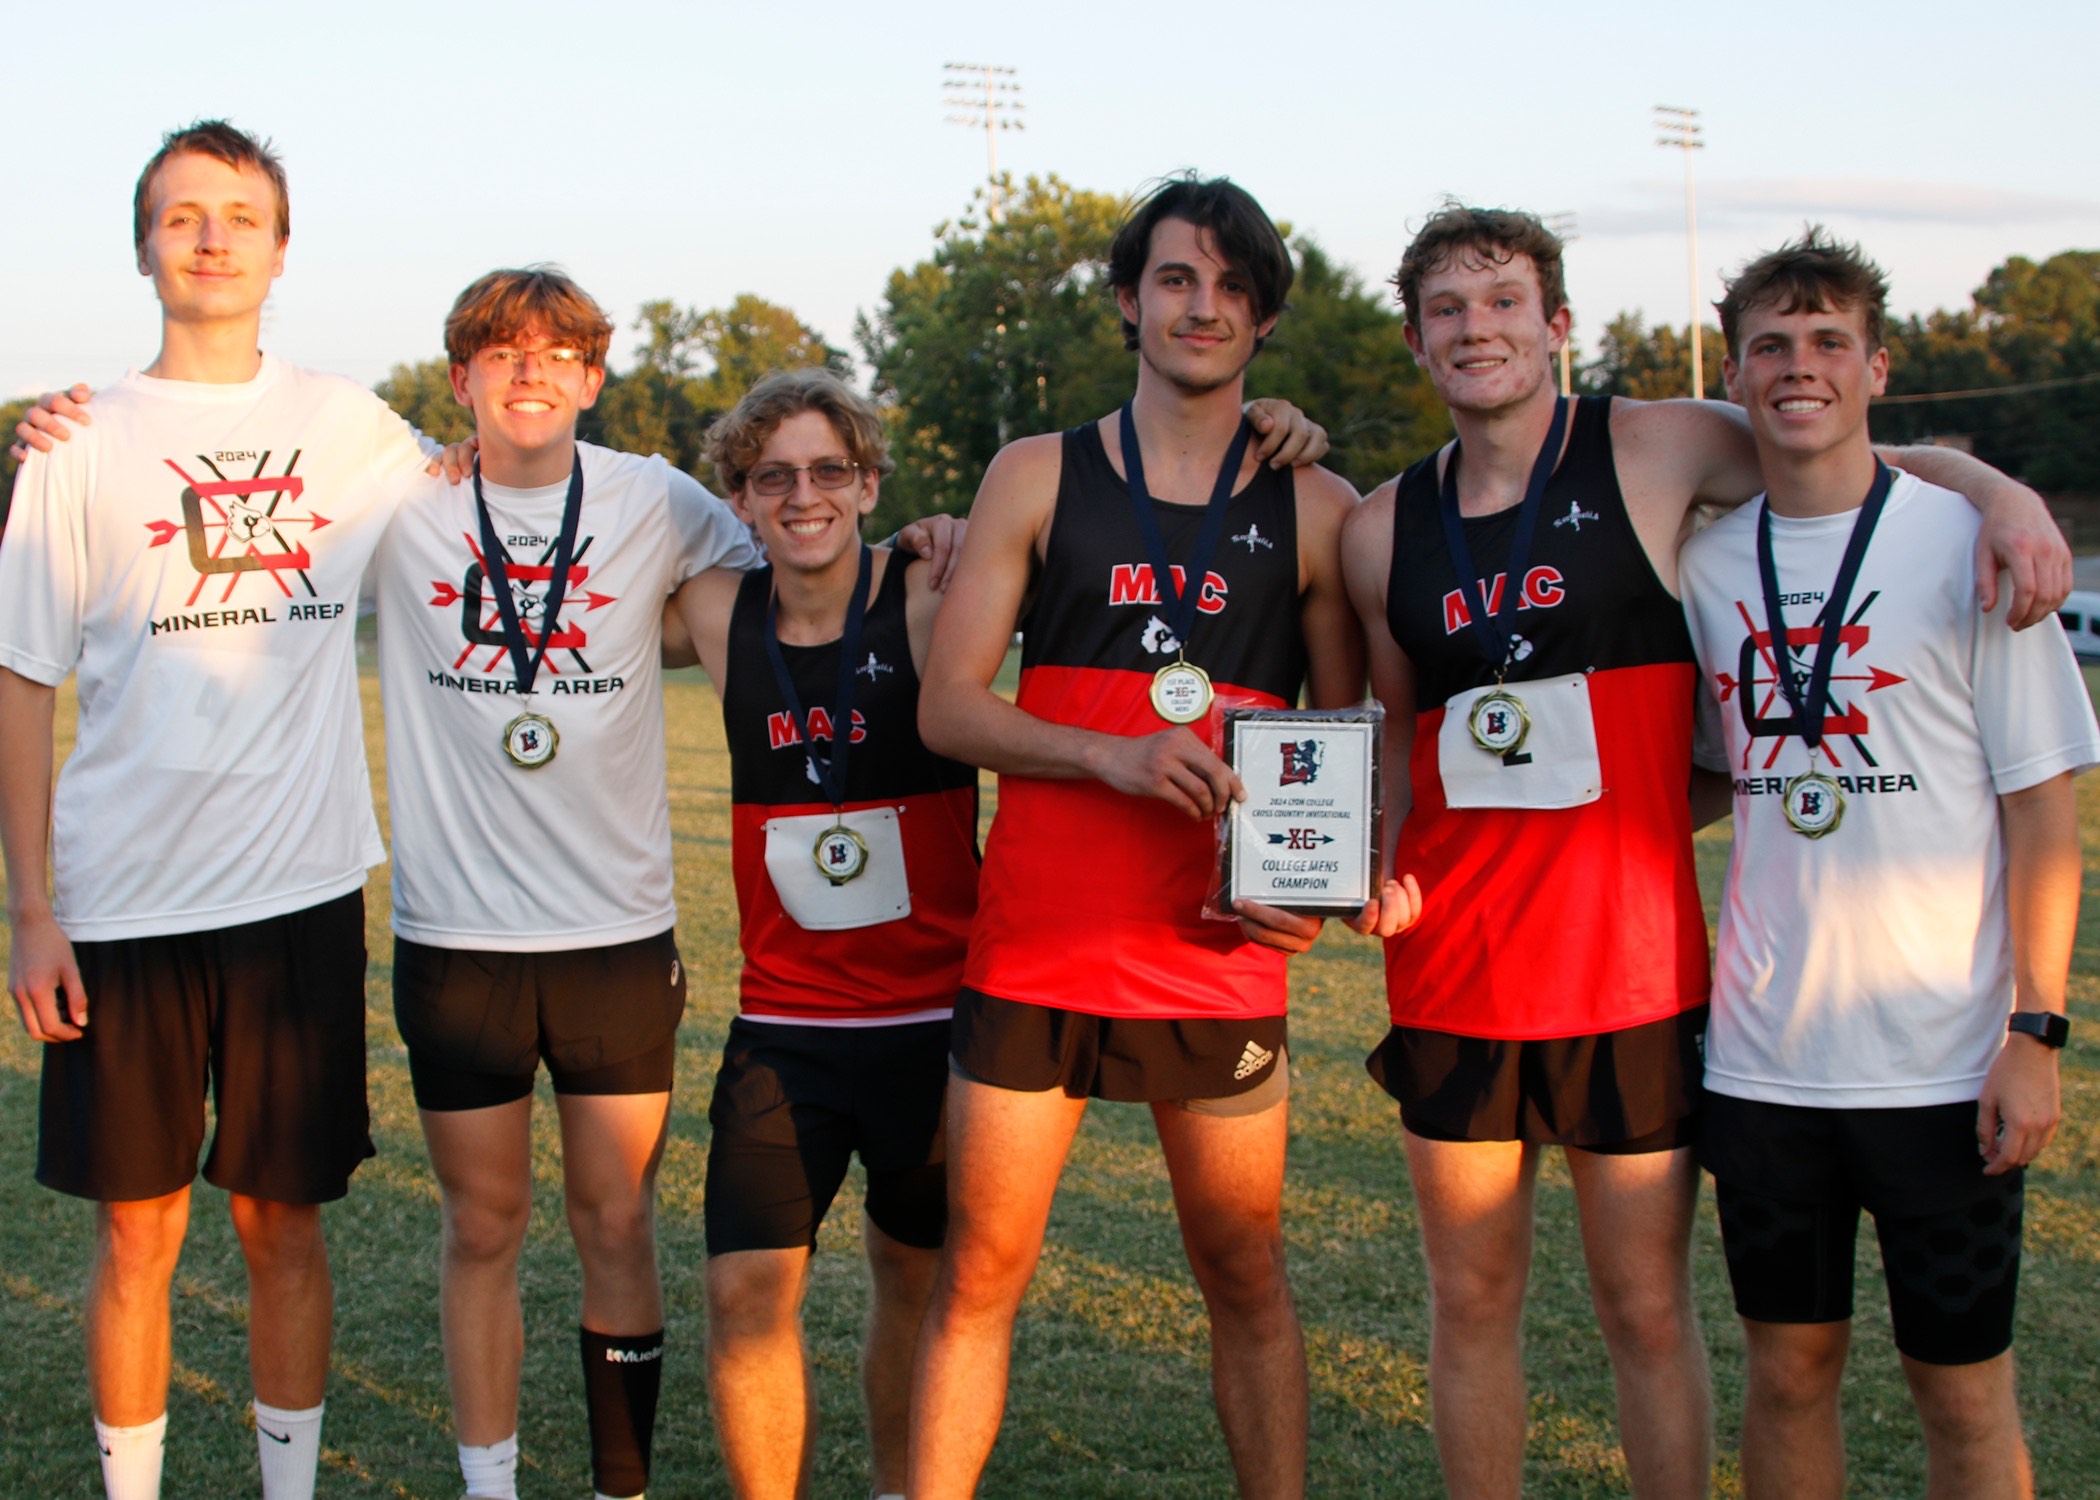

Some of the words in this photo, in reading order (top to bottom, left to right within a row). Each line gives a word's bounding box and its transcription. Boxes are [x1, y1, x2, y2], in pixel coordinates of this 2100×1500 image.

[214, 450, 257, 462] 2024
[507, 535, 548, 546] 2024
[1442, 565, 1566, 635] MC
[1778, 591, 1824, 606] 2024
[150, 607, 276, 635] MINERAL
[428, 669, 540, 694] MINERA
[552, 677, 624, 694] AREA
[1252, 809, 1273, 818] CROSS
[1274, 809, 1305, 818] COUNTRY
[1306, 810, 1351, 819] INVITATIONAL
[1288, 828, 1317, 850] XC
[1262, 859, 1307, 872] COLLEGE
[1308, 860, 1339, 873] MENS
[1272, 877, 1329, 889] CHAMPION
[1234, 1050, 1274, 1080] adidas
